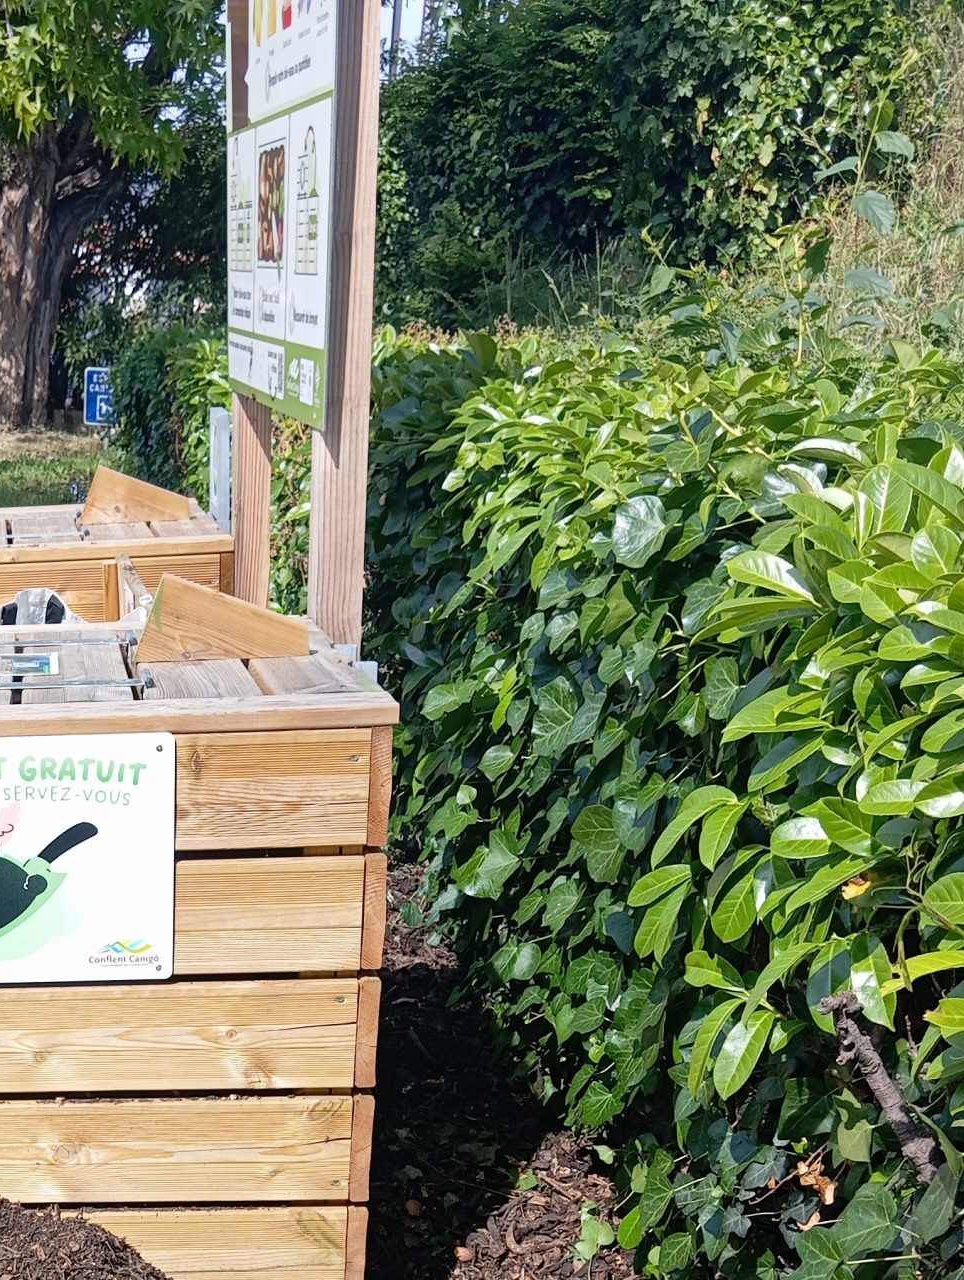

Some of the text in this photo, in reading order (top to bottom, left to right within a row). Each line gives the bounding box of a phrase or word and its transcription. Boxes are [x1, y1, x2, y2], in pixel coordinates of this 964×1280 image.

[18, 755, 148, 786] GRATUIT
[3, 785, 132, 807] SERVEZ-VOUS
[88, 953, 160, 965] Conflent Canigó
